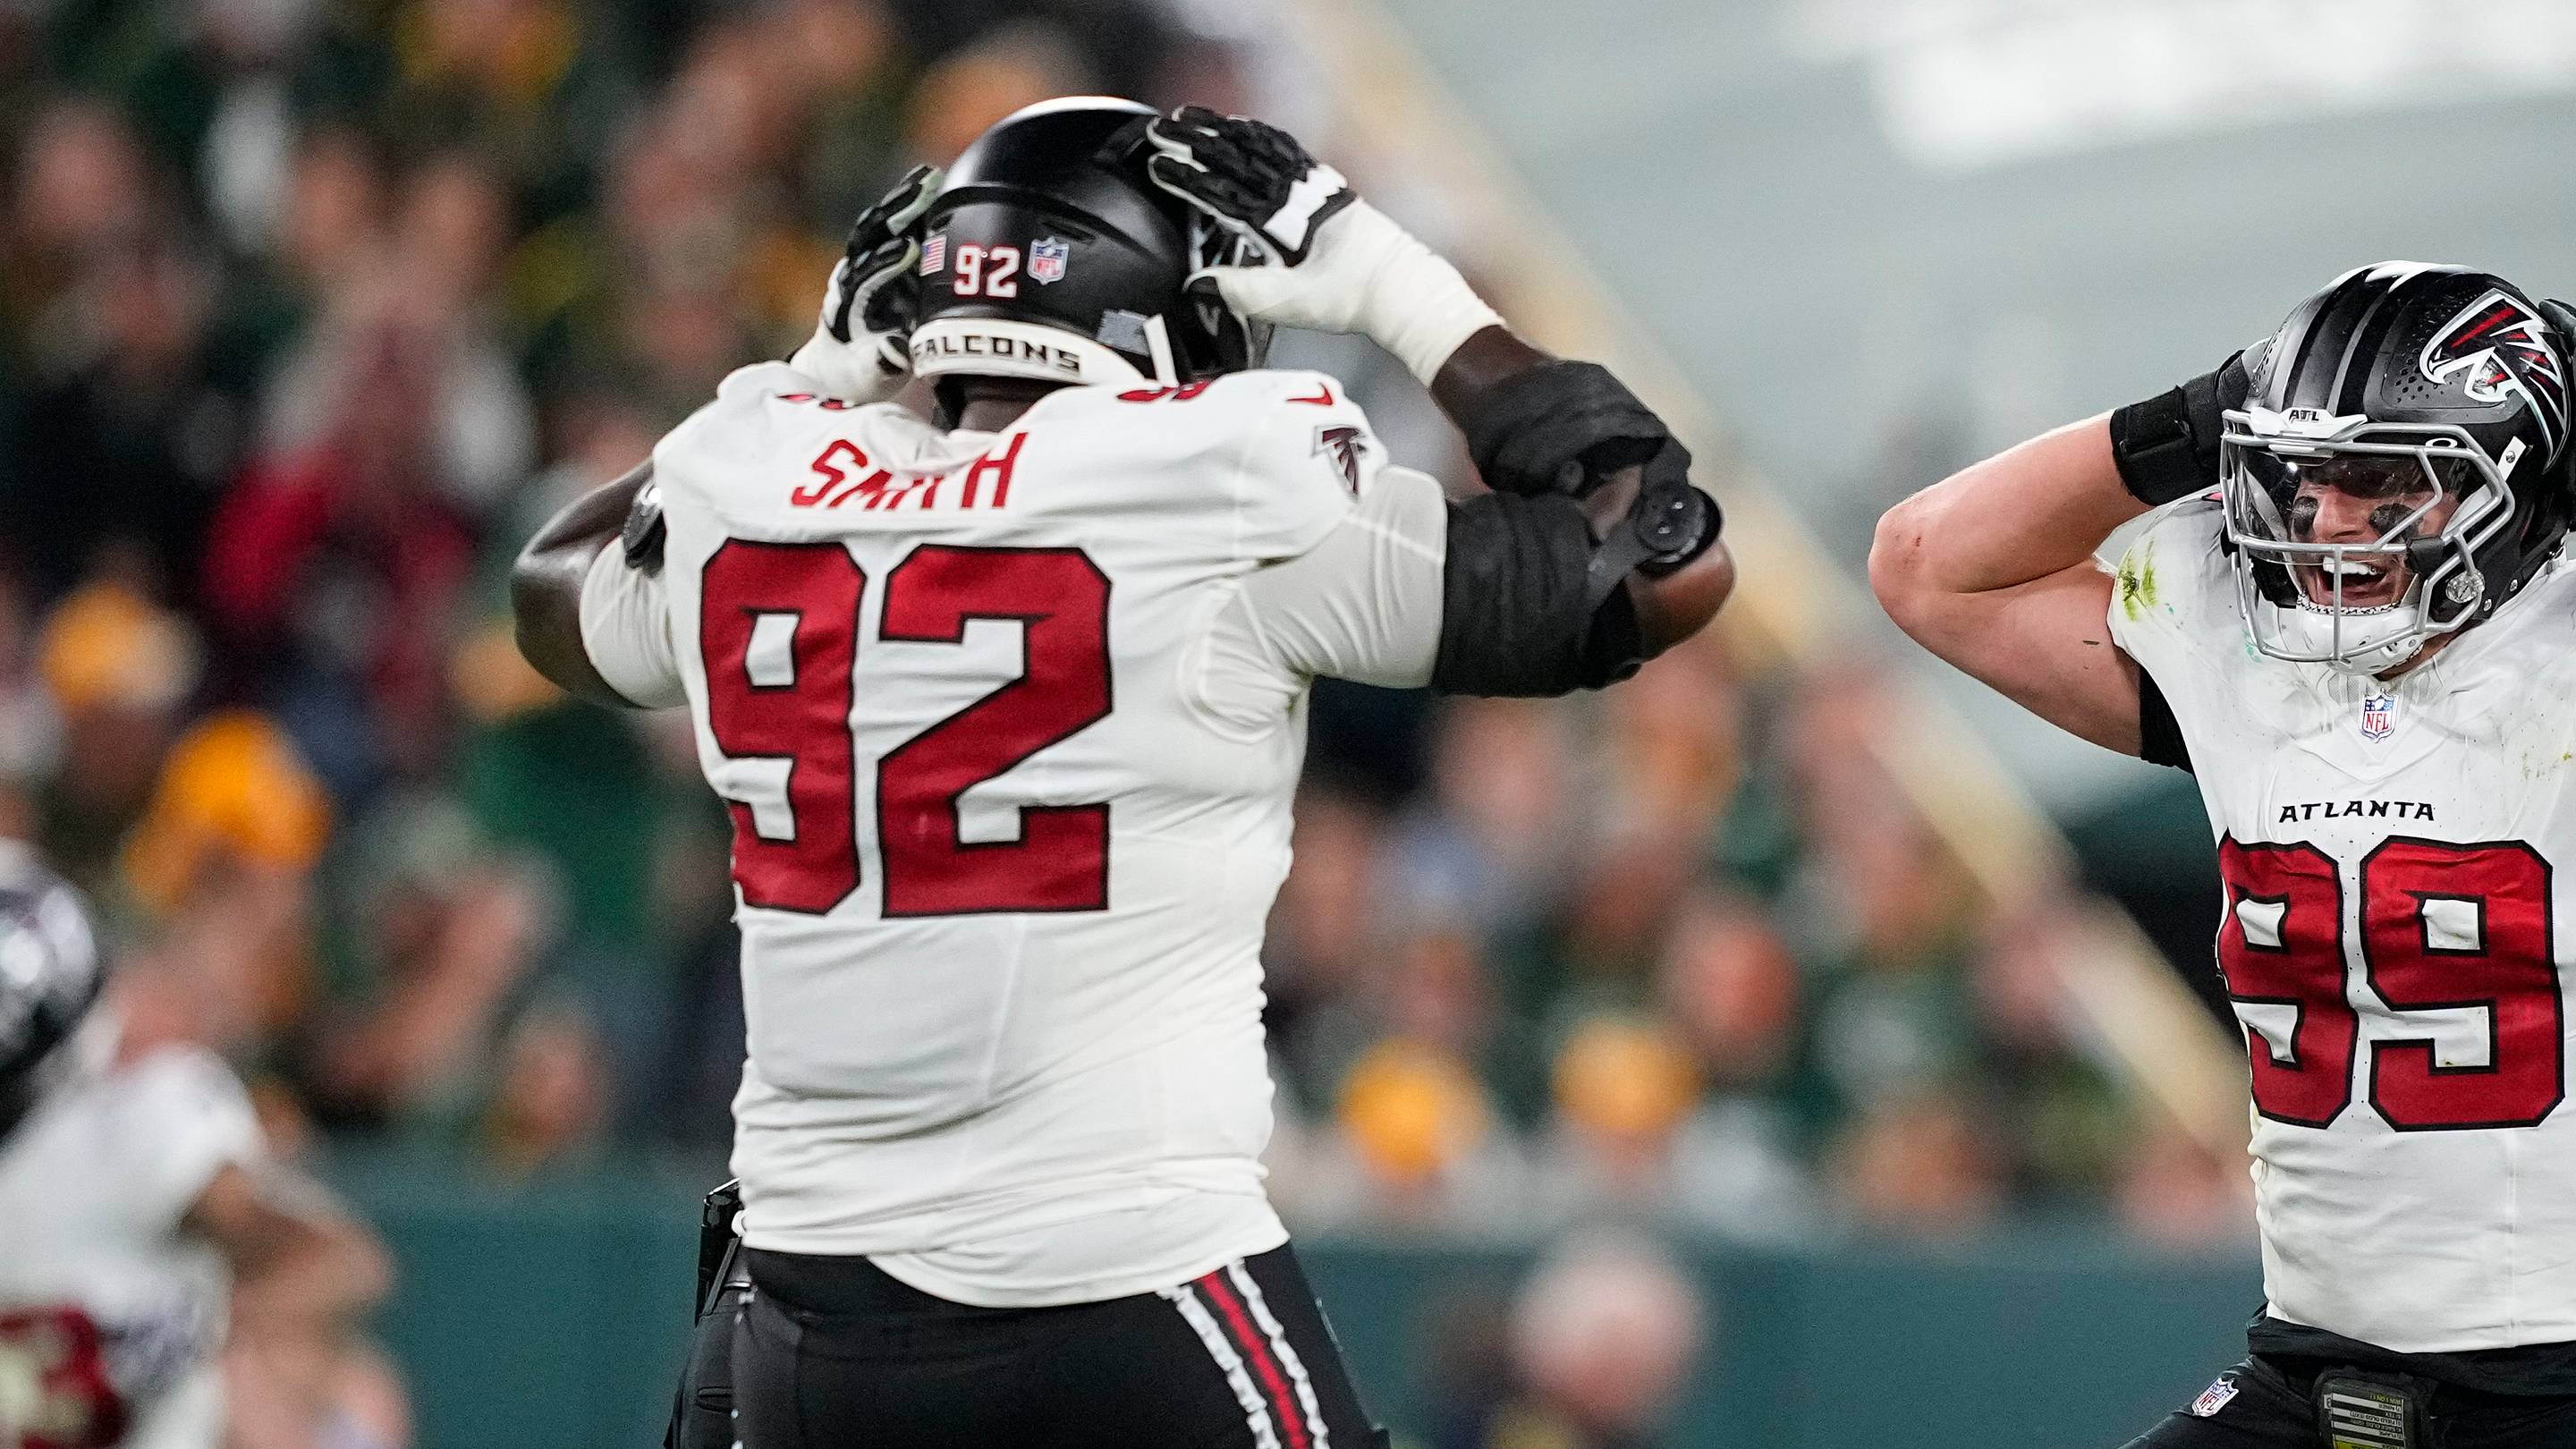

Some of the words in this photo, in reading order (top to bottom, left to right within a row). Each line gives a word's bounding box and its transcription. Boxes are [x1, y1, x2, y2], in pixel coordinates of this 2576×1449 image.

[953, 242, 1021, 298] 92
[2289, 410, 2319, 421] ATL
[699, 537, 1113, 919] 92
[2366, 713, 2389, 733] NFL
[2279, 801, 2435, 823] ATLANTA
[2217, 827, 2565, 1132] 99
